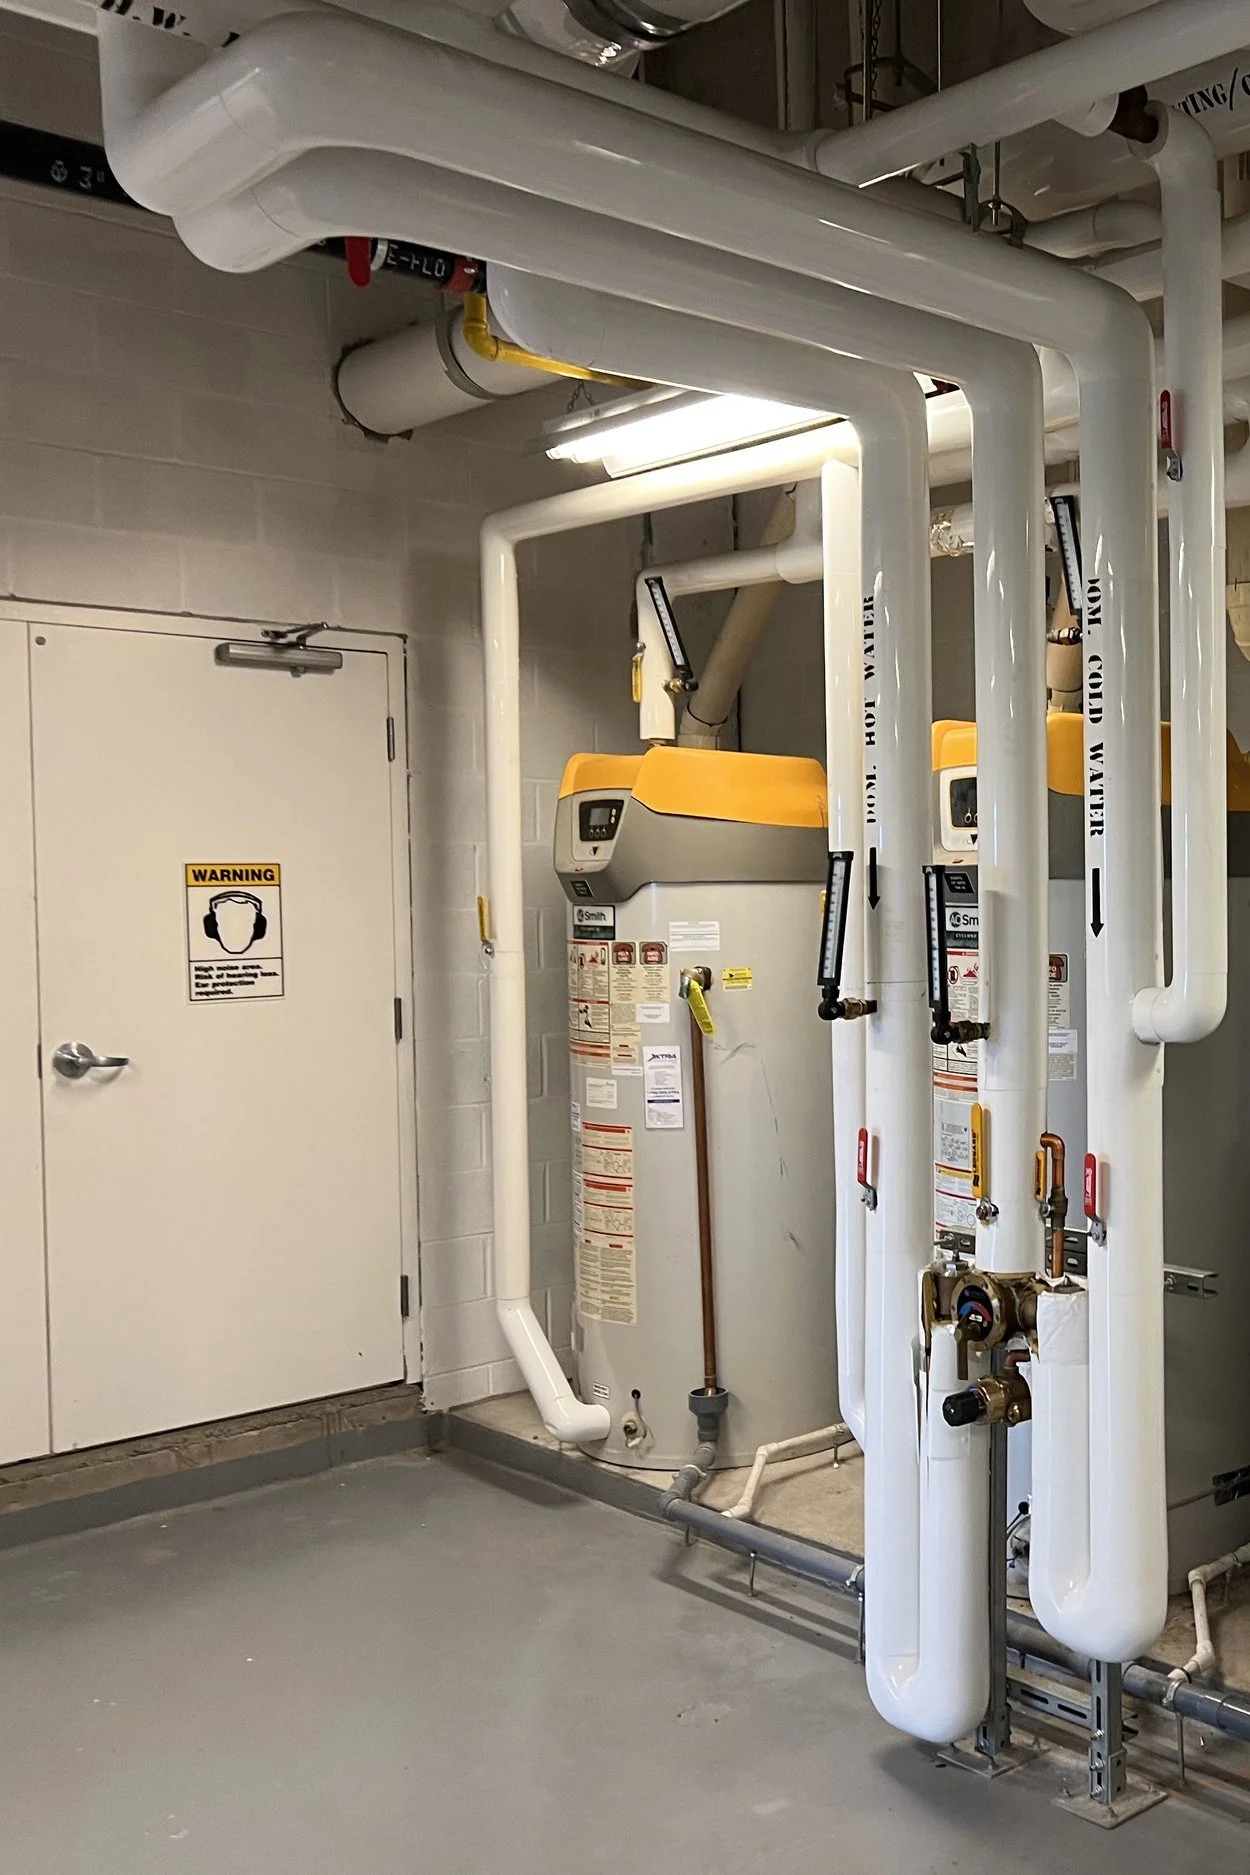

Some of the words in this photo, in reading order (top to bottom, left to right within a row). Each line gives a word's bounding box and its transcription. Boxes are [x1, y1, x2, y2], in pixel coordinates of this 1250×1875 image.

[863, 595, 876, 680] WATER
[1088, 654, 1104, 724] COLD
[864, 698, 876, 746] HOT
[865, 765, 878, 824] DOM.
[1089, 742, 1105, 838] WATER
[192, 868, 275, 882] WARNING
[194, 965, 214, 973] High
[211, 980, 255, 989] protection
[216, 972, 225, 980] of
[226, 971, 258, 979] hearing
